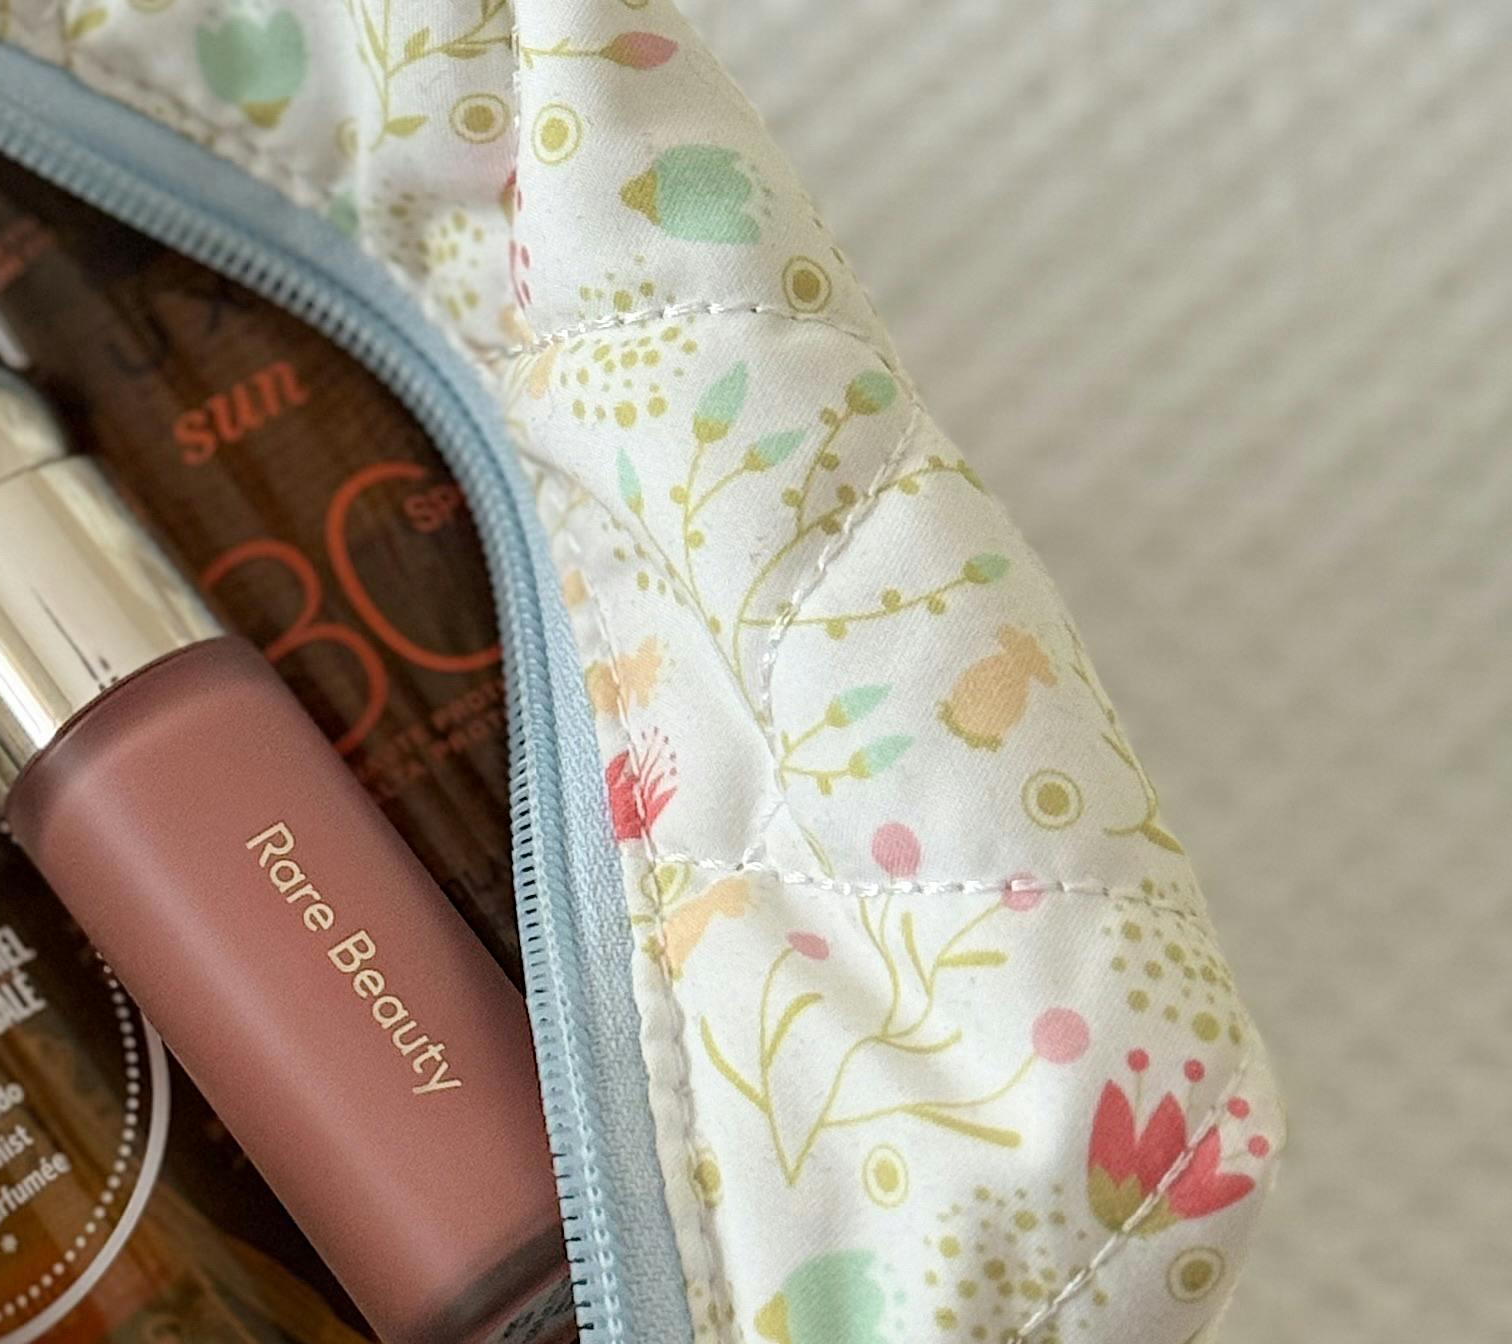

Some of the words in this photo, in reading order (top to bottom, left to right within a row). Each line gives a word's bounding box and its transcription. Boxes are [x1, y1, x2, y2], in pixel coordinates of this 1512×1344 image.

[173, 361, 311, 465] sun
[245, 821, 335, 932] Rare
[326, 929, 463, 1096] Beauty
